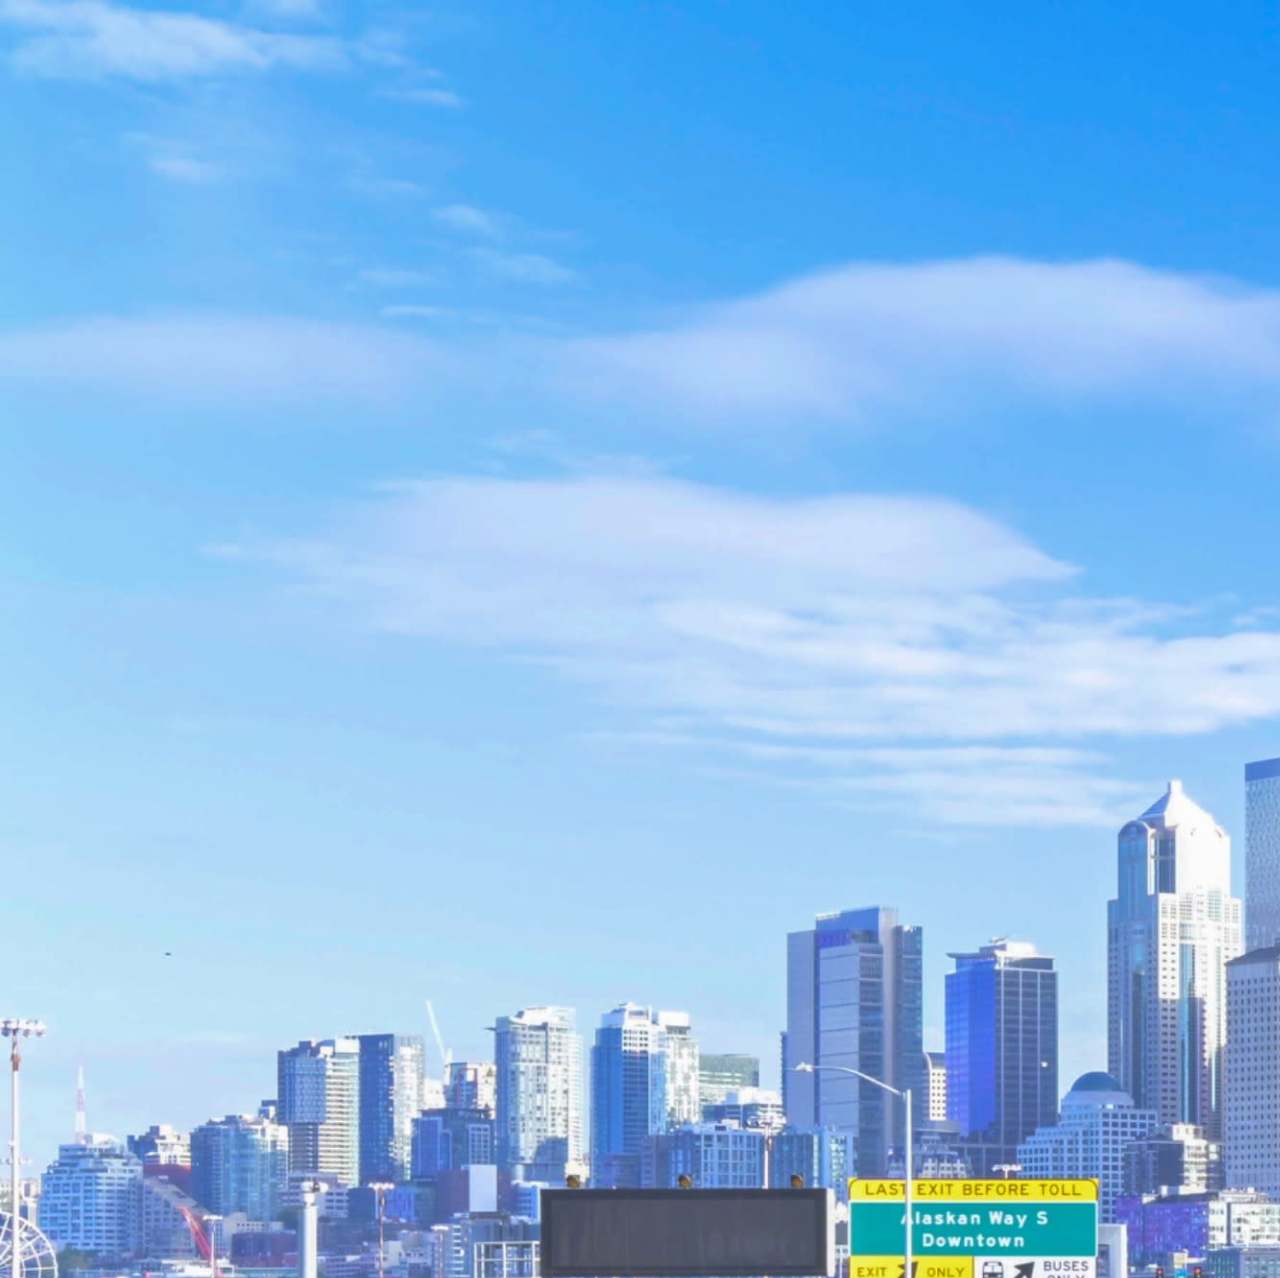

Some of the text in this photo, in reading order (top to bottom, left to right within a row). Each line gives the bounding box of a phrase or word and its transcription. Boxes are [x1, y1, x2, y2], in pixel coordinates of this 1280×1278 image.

[865, 1183, 1081, 1196] LAST EXIT BEFORE TOLL
[989, 1211, 1027, 1228] Way
[1037, 1211, 1048, 1225] S
[922, 1233, 1025, 1247] Downtown
[857, 1266, 965, 1277] EXIT ONLY
[1043, 1261, 1089, 1272] BUSES
